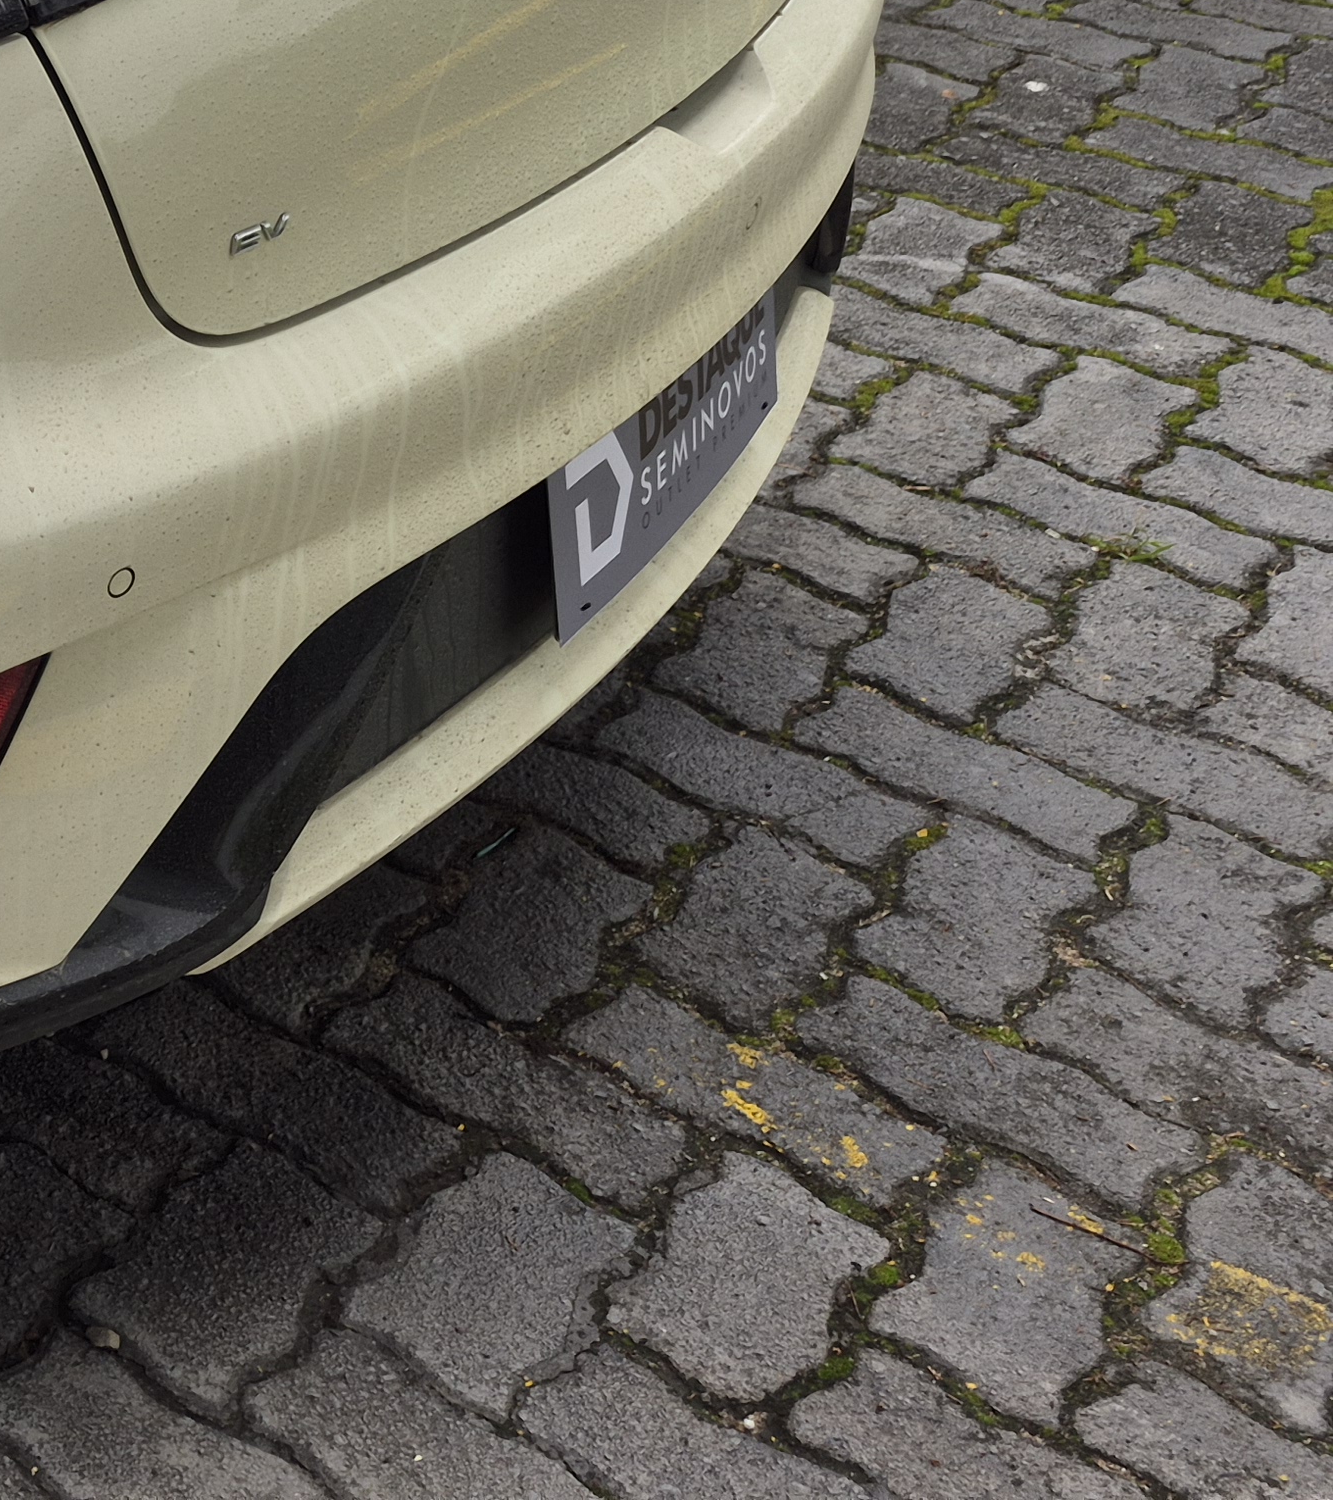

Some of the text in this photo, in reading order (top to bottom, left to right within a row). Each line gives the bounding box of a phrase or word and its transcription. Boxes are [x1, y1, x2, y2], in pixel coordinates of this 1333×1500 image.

[229, 211, 290, 258] EV
[640, 328, 767, 506] SEMINOVOS
[642, 454, 701, 530] OUTLET
